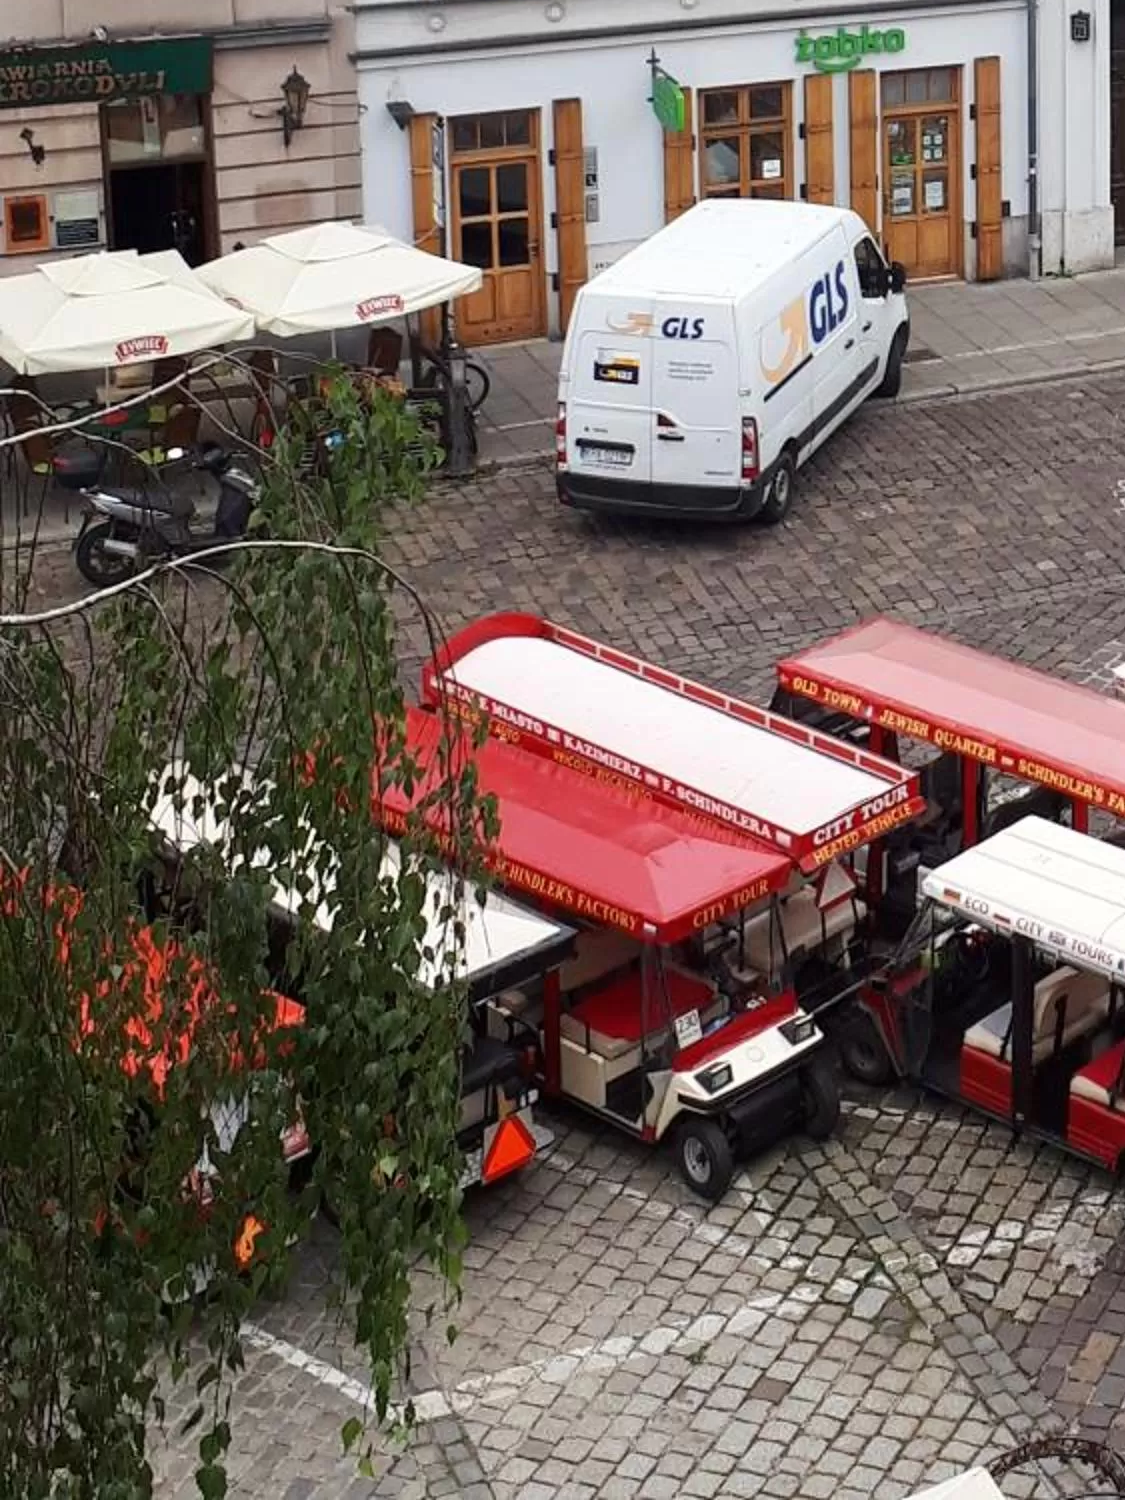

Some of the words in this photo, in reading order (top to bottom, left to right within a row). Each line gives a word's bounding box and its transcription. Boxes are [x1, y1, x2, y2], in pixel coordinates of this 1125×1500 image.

[661, 317, 705, 340] GLS
[809, 259, 849, 344] GLS
[491, 701, 543, 736] MIASTO
[563, 733, 642, 780] KAZIMIERZ
[676, 783, 772, 839] SCHINDLERA
[793, 677, 818, 695] OLD
[823, 688, 861, 712] TOWN
[879, 709, 929, 738] JEWISH
[934, 728, 996, 763] QUARTER
[1018, 759, 1104, 802] SCHINDLER'S
[812, 831, 860, 864] HEATED
[865, 804, 912, 837] VEHICLE
[813, 811, 854, 846] CITY
[861, 784, 909, 821] TOUR
[495, 858, 573, 903] SCHINDLER'S
[576, 888, 638, 932] FACTORY
[692, 899, 728, 928] CITY
[733, 879, 769, 909] TOUR
[964, 897, 989, 916] ECO
[1016, 917, 1046, 937] CITY
[1071, 938, 1114, 966] TOURS
